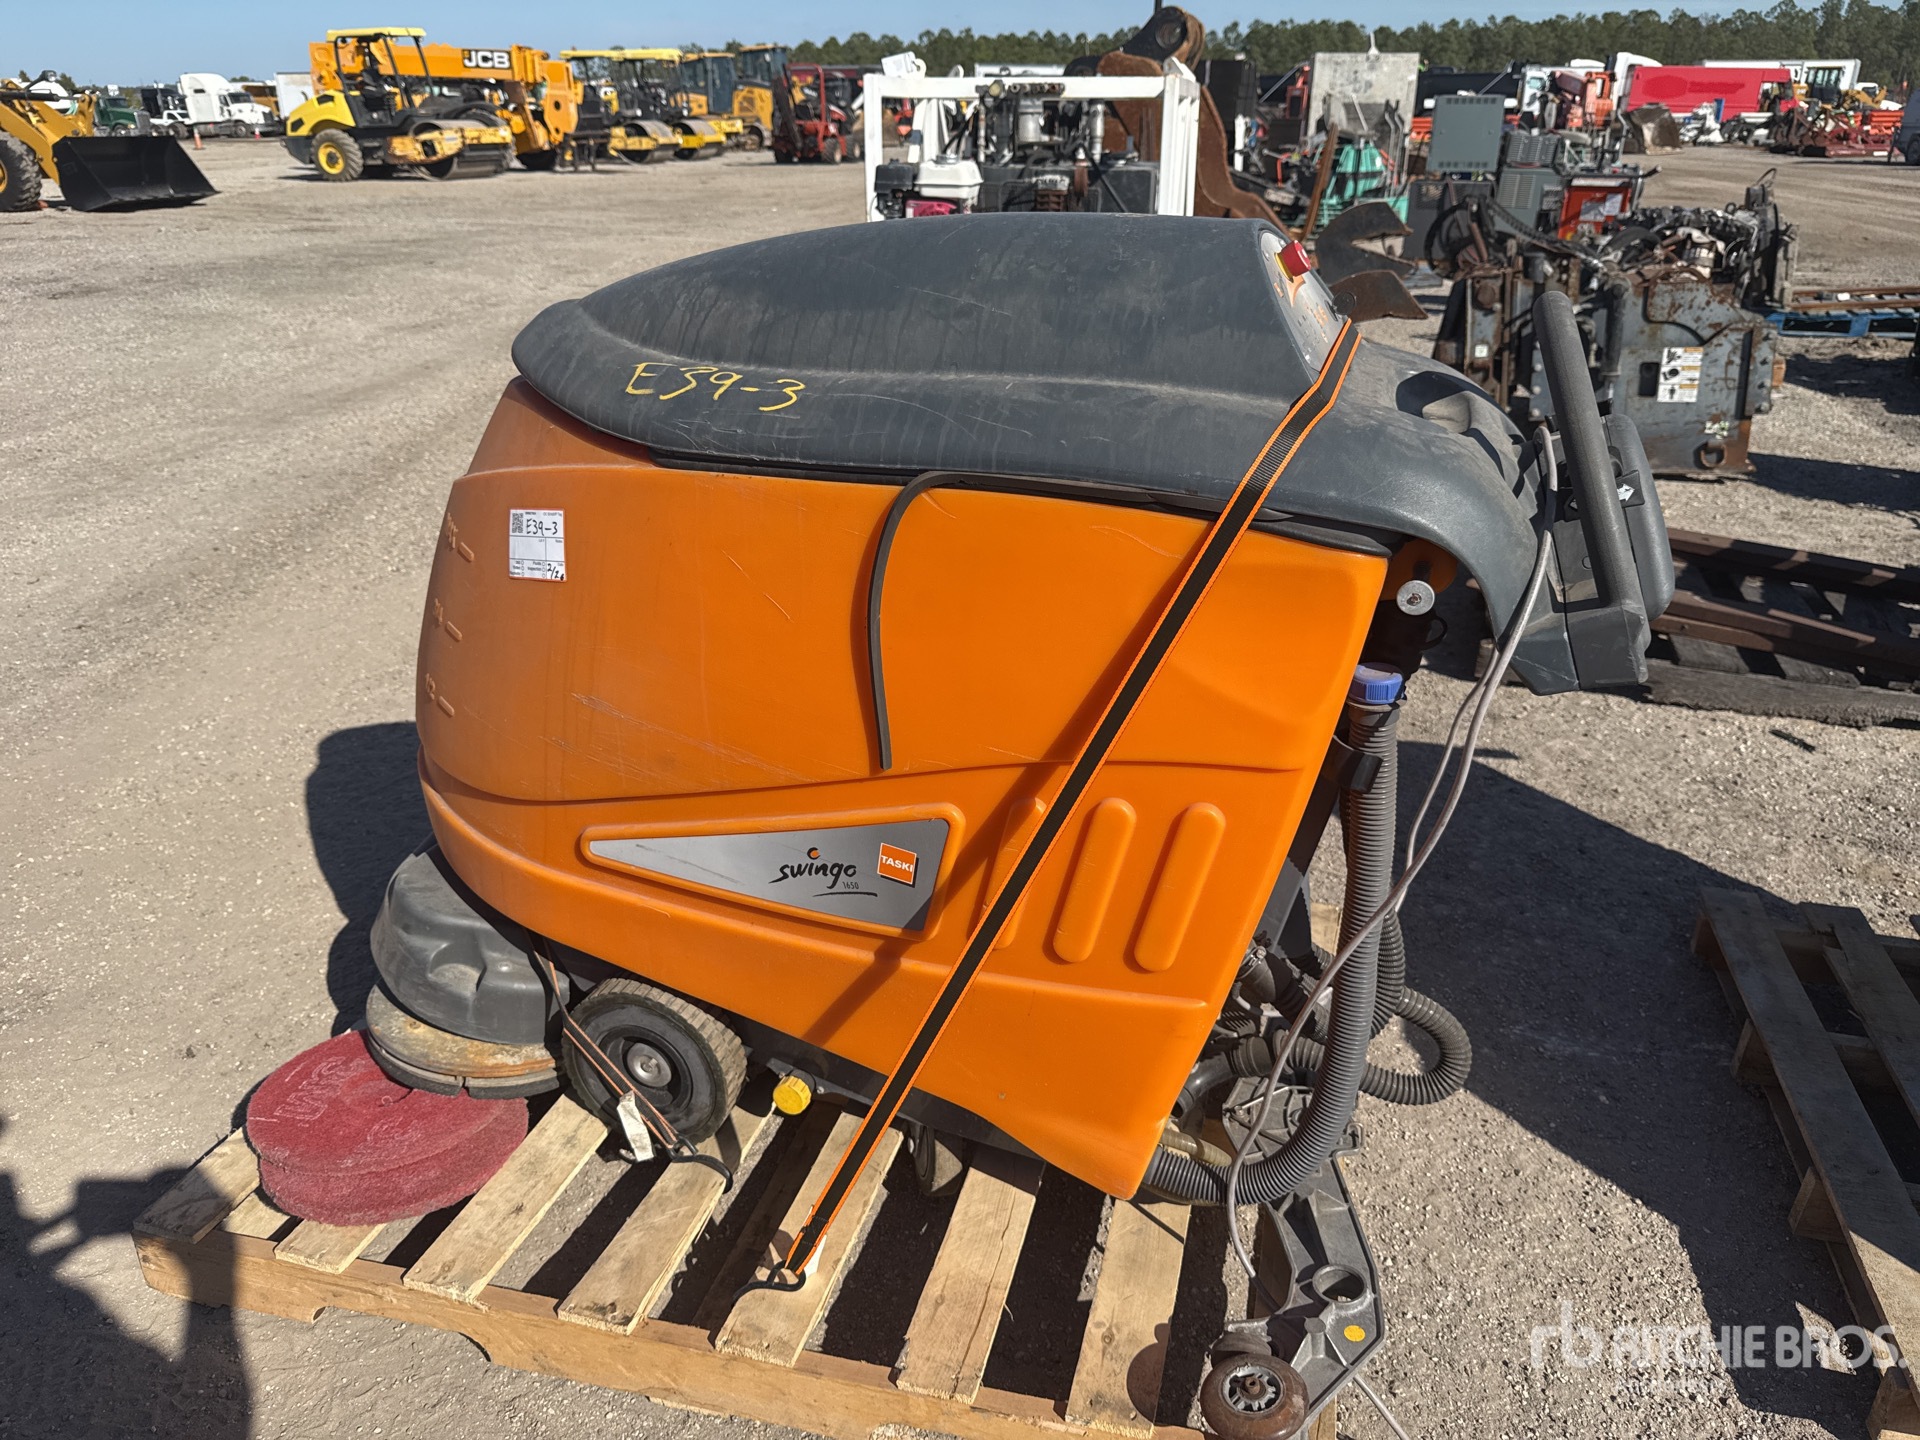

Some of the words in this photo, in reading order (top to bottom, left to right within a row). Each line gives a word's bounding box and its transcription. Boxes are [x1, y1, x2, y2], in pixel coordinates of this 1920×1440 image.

[463, 50, 511, 69] JCB
[625, 362, 806, 412] E39-3
[526, 518, 558, 536] E39-3
[768, 847, 857, 890] swingo
[881, 855, 913, 872] TASKI
